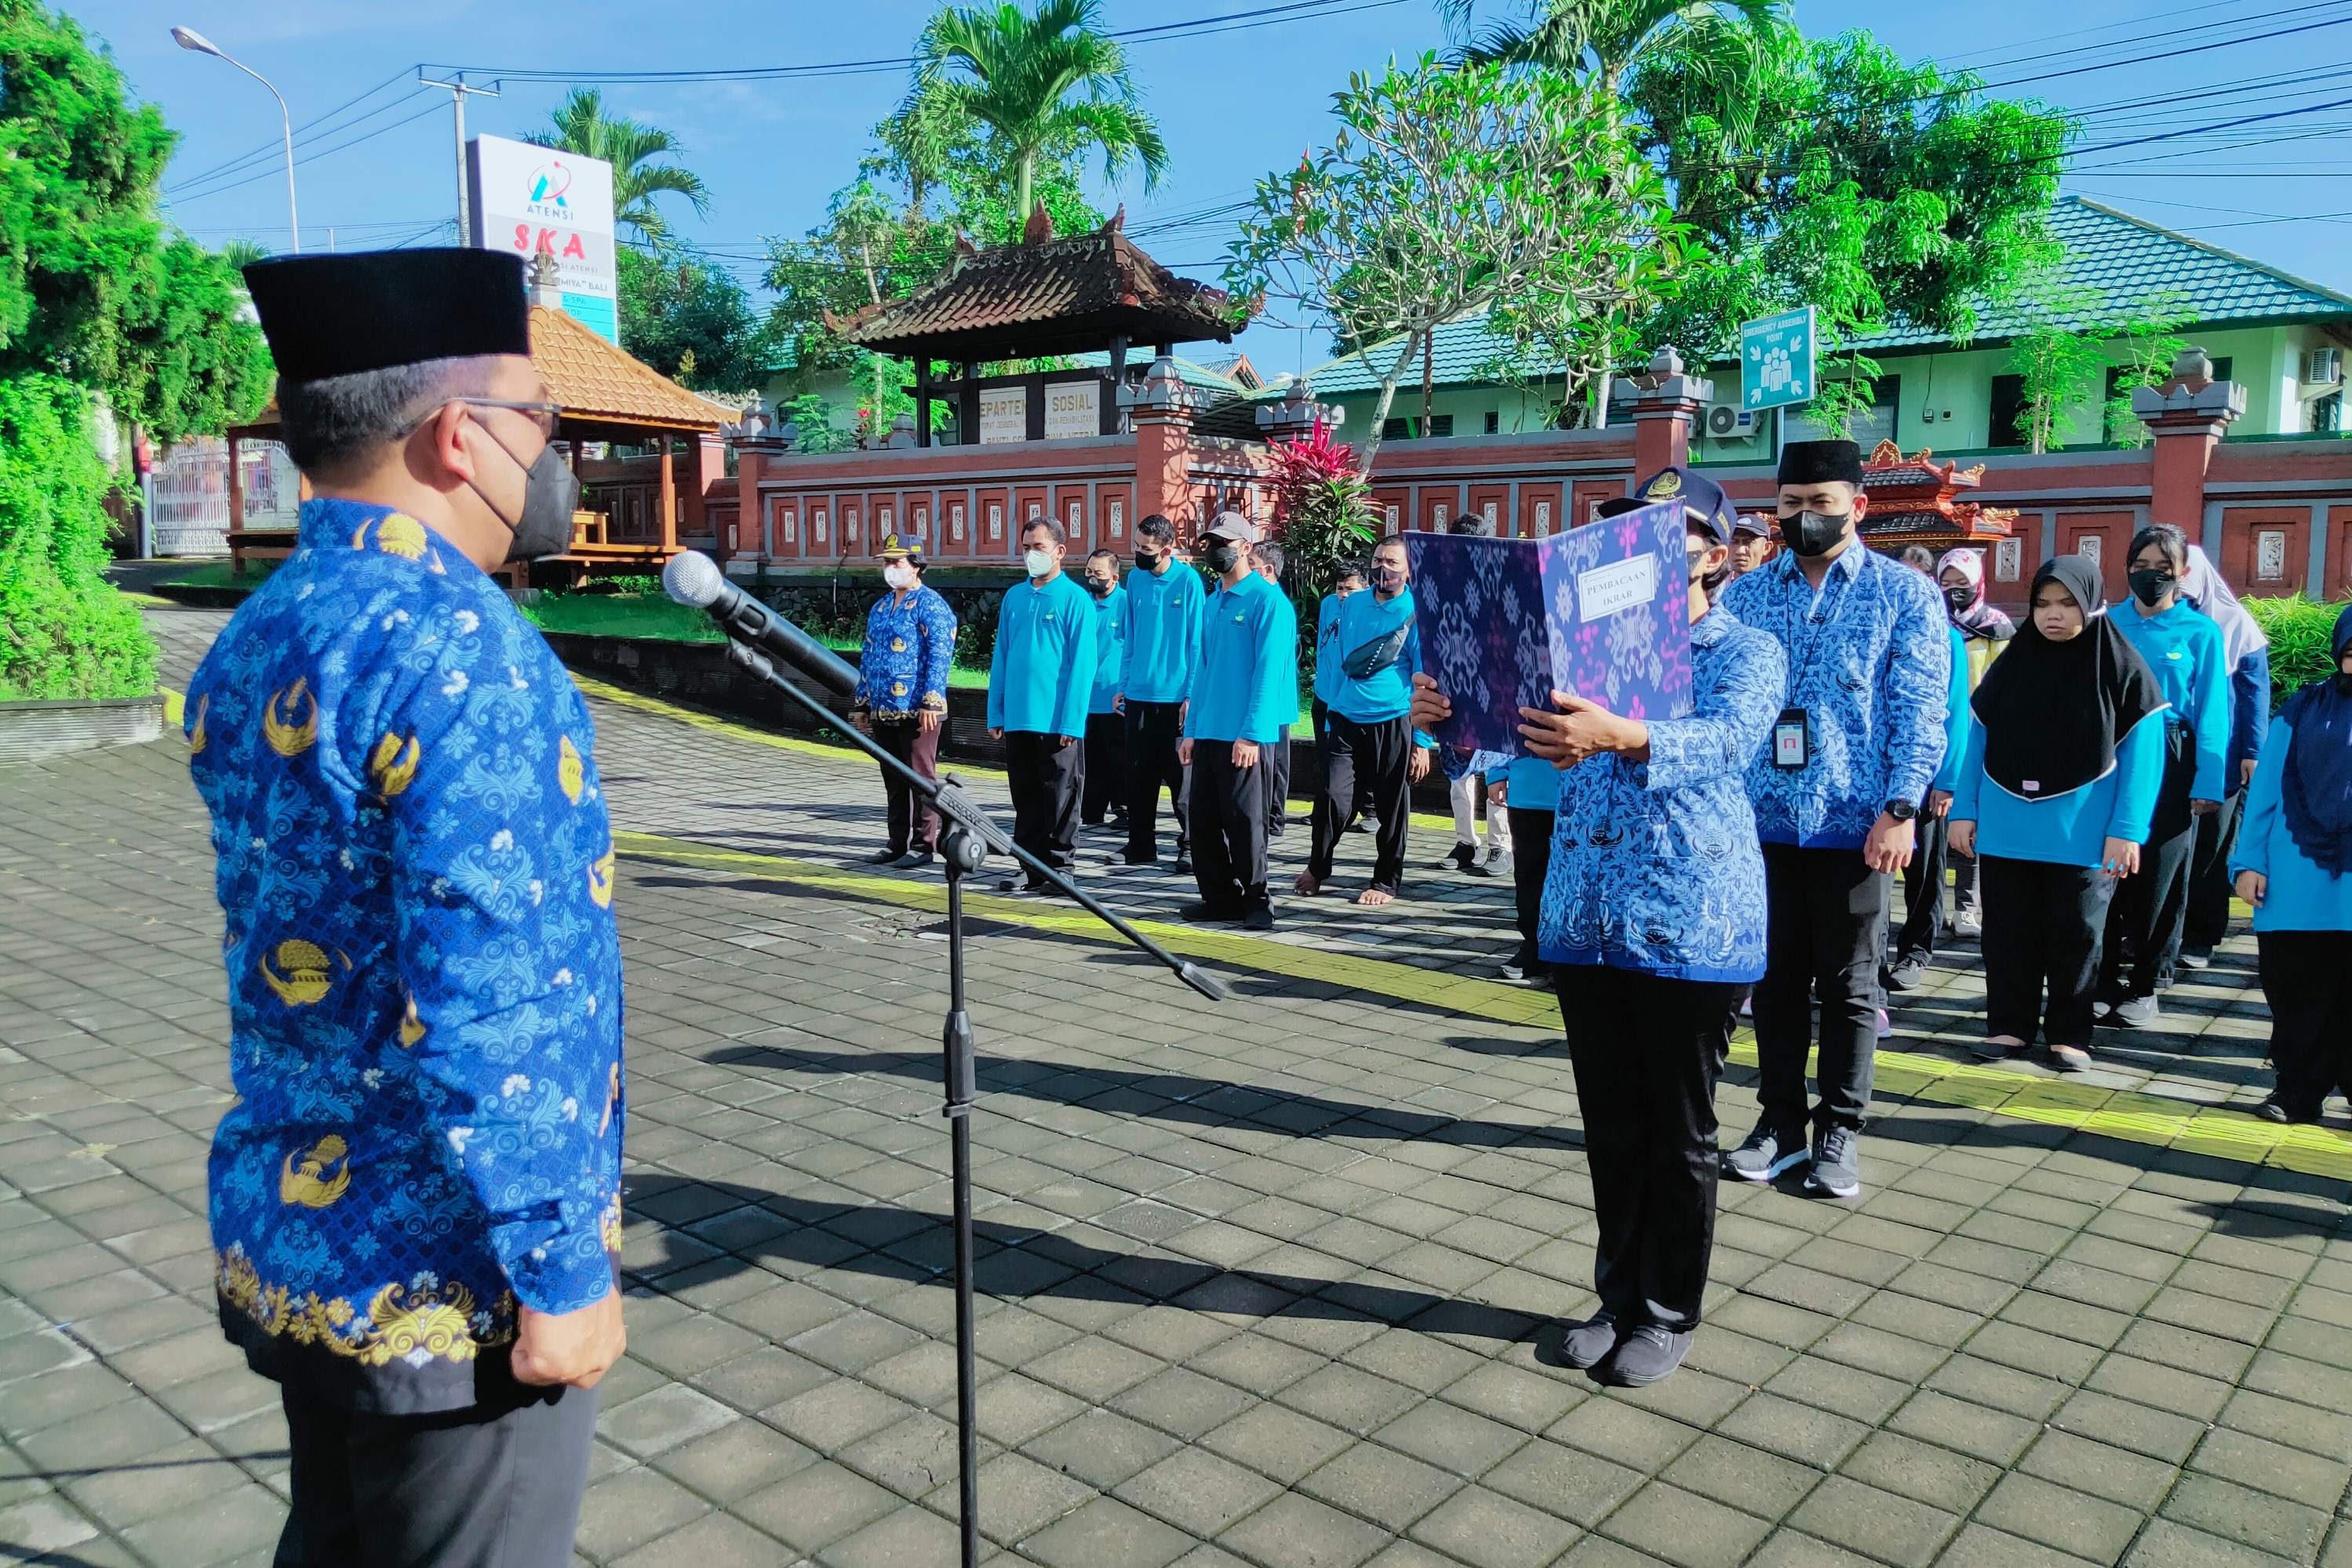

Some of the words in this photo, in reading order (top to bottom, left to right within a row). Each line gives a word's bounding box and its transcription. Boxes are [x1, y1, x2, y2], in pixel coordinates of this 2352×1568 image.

[526, 205, 573, 220] ATENSI
[514, 224, 586, 260] SKA
[570, 264, 598, 273] ATENSI
[588, 282, 607, 291] BALI
[1743, 322, 1776, 337] EMERGENCY
[1778, 315, 1807, 329] ASSEMBLY
[1766, 332, 1783, 344] POINT
[980, 399, 1025, 417] EPARTE
[1052, 394, 1093, 412] SOSIAL
[1587, 569, 1647, 595] PEMBACAAN
[1603, 590, 1633, 606] IKRAR
